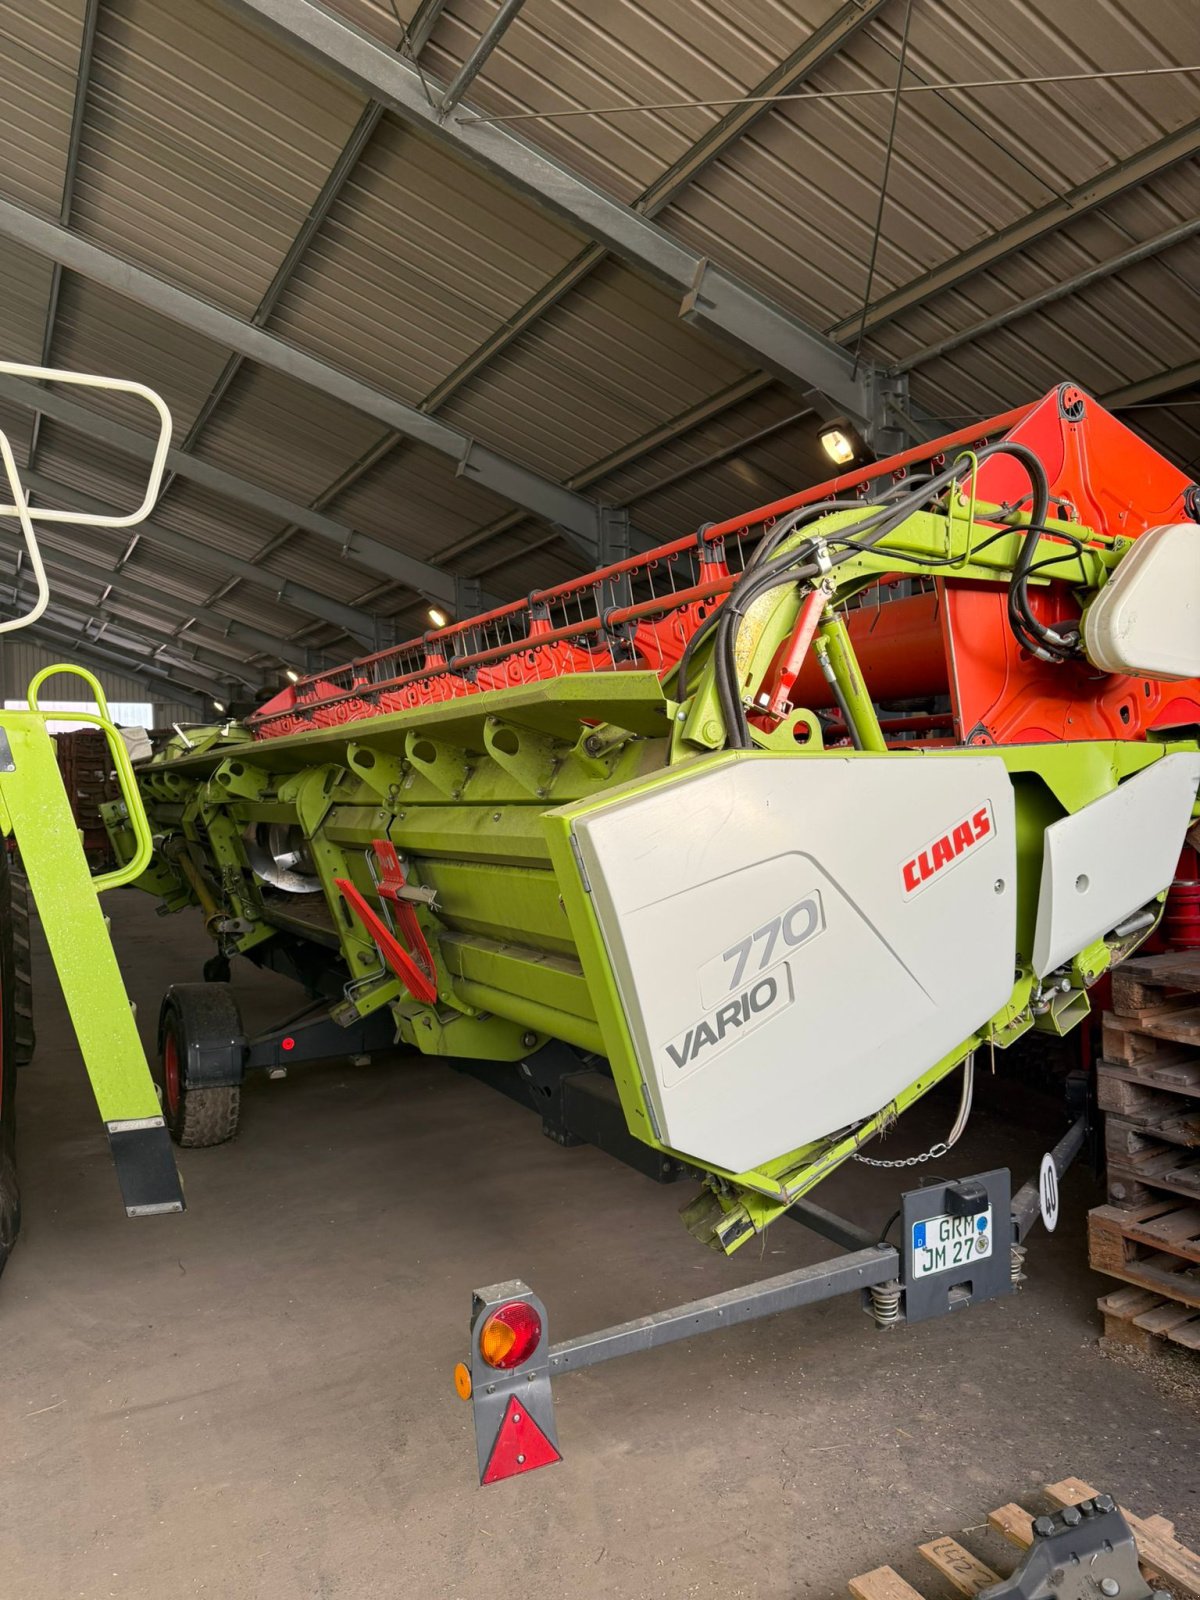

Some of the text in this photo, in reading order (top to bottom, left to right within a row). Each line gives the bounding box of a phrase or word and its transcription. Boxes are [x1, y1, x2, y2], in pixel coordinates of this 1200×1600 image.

[902, 807, 991, 893] CLAAS
[722, 899, 819, 991] 770
[665, 976, 778, 1069] VARIO
[1043, 1165, 1056, 1219] 40
[917, 1238, 923, 1247] D
[922, 1237, 974, 1272] JM 27
[939, 1215, 975, 1242] GRM
